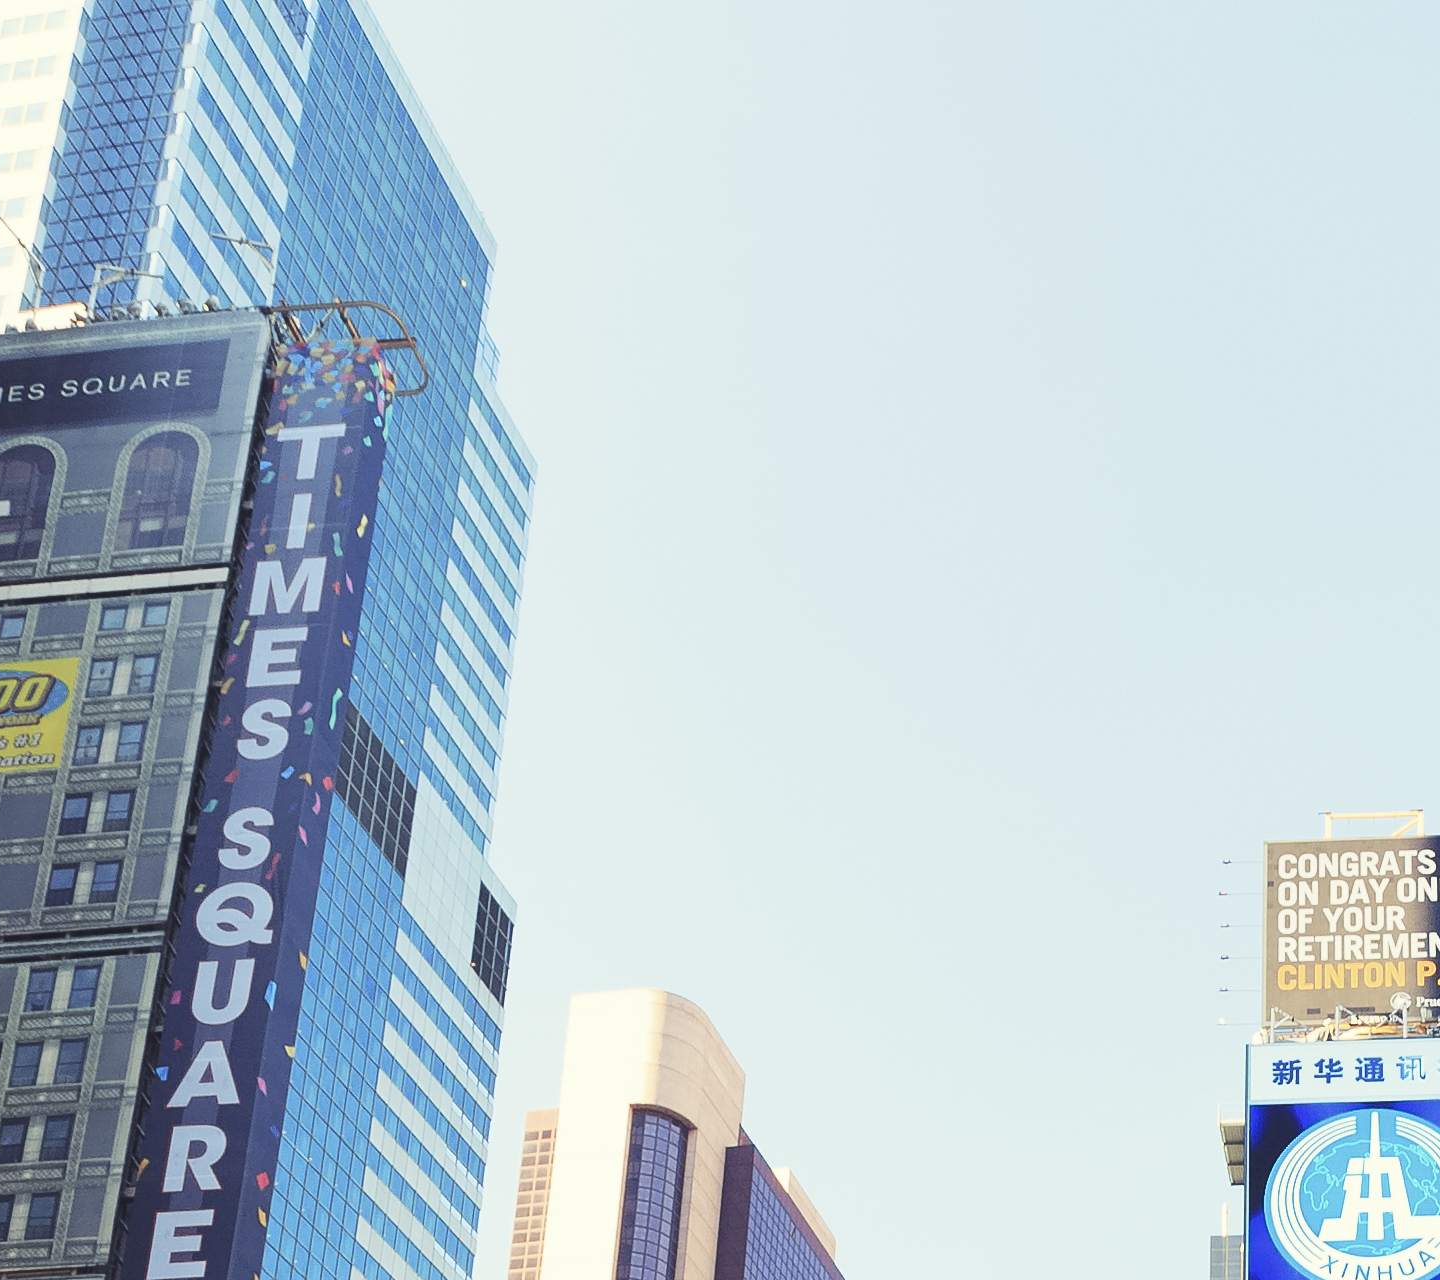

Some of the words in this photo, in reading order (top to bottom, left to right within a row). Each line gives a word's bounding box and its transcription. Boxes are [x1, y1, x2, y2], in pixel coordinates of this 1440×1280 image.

[61, 369, 193, 398] SQUARE
[14, 733, 42, 749] #1
[1277, 849, 1437, 880] CONGRATS
[1277, 879, 1321, 906] ON
[1329, 877, 1389, 905] DAY
[1277, 907, 1317, 934] OF
[1324, 906, 1405, 933] YOUR
[1277, 961, 1408, 990] CLINTON
[145, 806, 274, 1280] SQUARE
